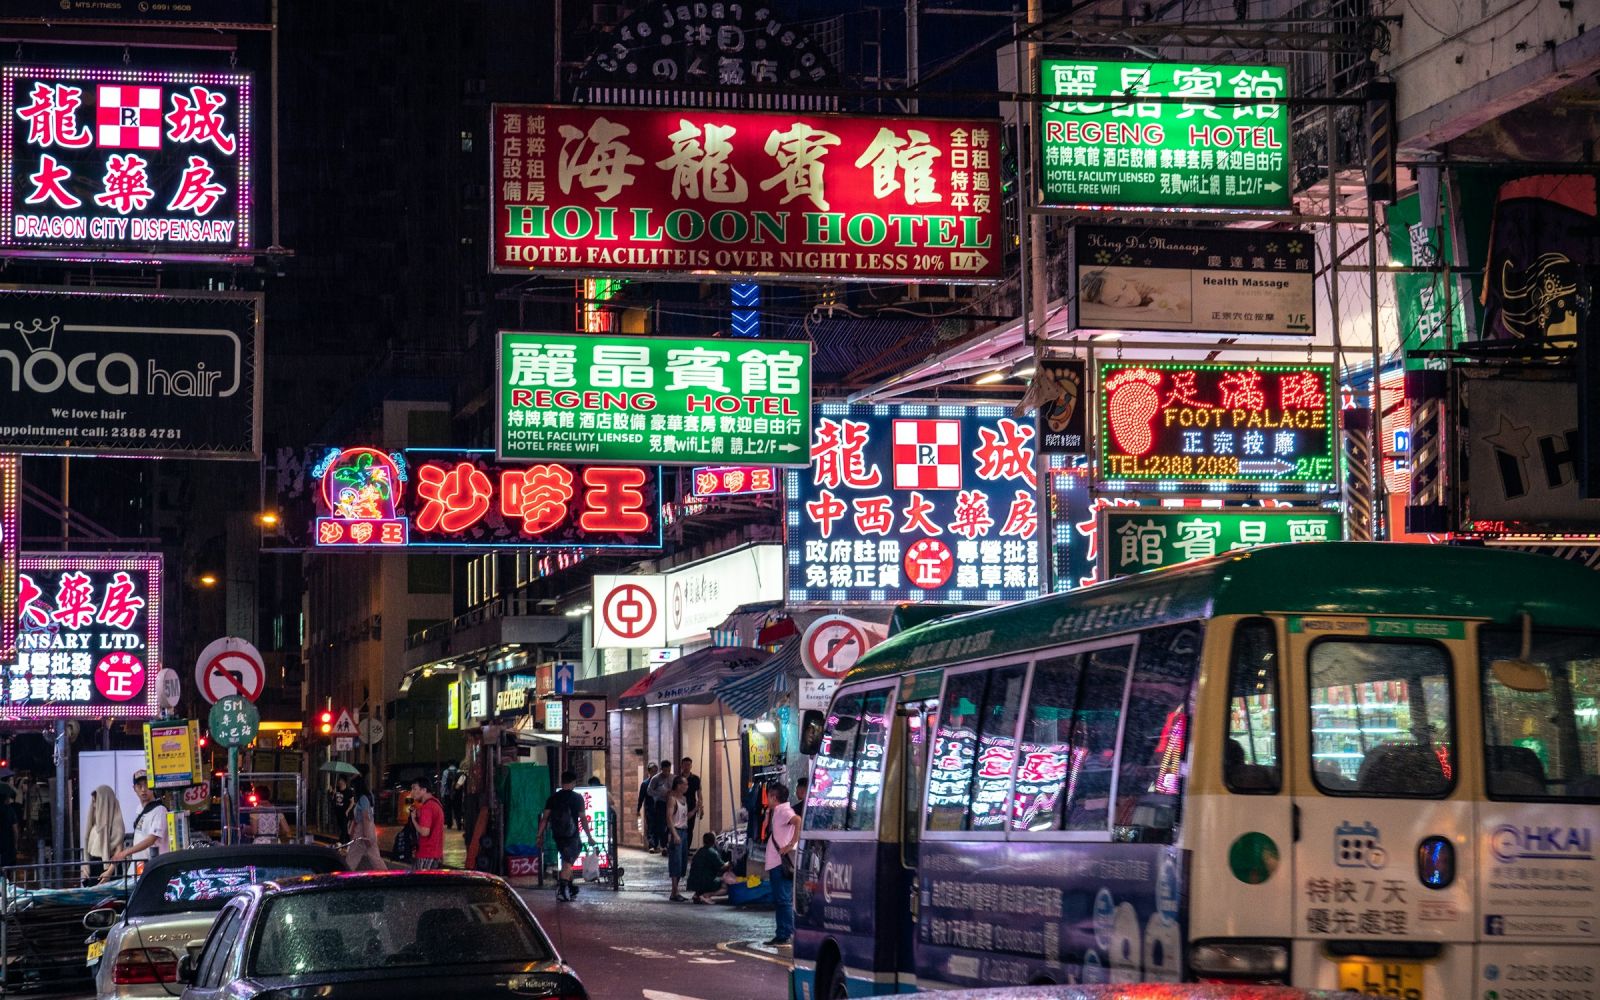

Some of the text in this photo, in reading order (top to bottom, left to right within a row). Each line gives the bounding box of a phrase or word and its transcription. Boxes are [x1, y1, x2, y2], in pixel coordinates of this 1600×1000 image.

[1045, 120, 1282, 149] REGENG HOTEL
[503, 113, 522, 202] 酒店設備
[526, 114, 546, 202] 純粹租房
[558, 116, 942, 212] 海龍賓館
[950, 127, 970, 212] 全日特平
[1046, 145, 1282, 172] 持牌賓館 酒店設備 豪華套房 歡迎自由行
[971, 127, 991, 214] 時租過夜
[1047, 170, 1155, 184] HOTEL FACILITY LIENSED
[25, 153, 227, 216] 大藥房
[1047, 182, 1121, 195] HOTEL FREE WIFI
[1160, 172, 1263, 197] 免費wifi上網 請上2/F
[15, 215, 235, 242] DRAGON CITY DISPENSARY
[504, 204, 992, 249] HOI LOON HOTEL
[504, 245, 945, 271] HOTEL FACILITEIS OVER NIGHT LESS 20%
[1149, 236, 1208, 255] Massage
[953, 255, 982, 270] 1/F
[1203, 276, 1289, 288] Health Massage
[1287, 313, 1306, 323] 1/F
[147, 358, 222, 397] hair
[508, 342, 804, 396] 麗晶賓館
[51, 408, 127, 421] We love hair
[511, 388, 799, 416] REGENG HOTEL
[507, 410, 802, 435] 持牌賓館 酒店設備 豪華套房 歡迎自由行
[1164, 407, 1326, 429] FOOT PALACE
[81, 426, 109, 438] call:
[111, 427, 147, 439] 2388
[149, 428, 182, 439] 4781
[507, 430, 644, 444] HOTEL FACILITY LIENSED
[649, 433, 777, 455] 免費wifi上網 請上2/F
[507, 440, 599, 453] HOTEL FREE WIFI
[1196, 456, 1239, 476] 2093
[806, 490, 1037, 540] 中西大藥房
[916, 558, 941, 584] 正
[100, 633, 146, 649] LTD.
[106, 671, 133, 696] 正
[164, 677, 180, 698] 5M
[223, 699, 243, 712] 5M
[496, 687, 525, 711] SKECHERS
[592, 722, 598, 731] 7
[593, 736, 604, 746] 12
[1306, 878, 1407, 904] 特快7天
[1306, 907, 1409, 936] 優先處理
[1362, 964, 1402, 987] LH
